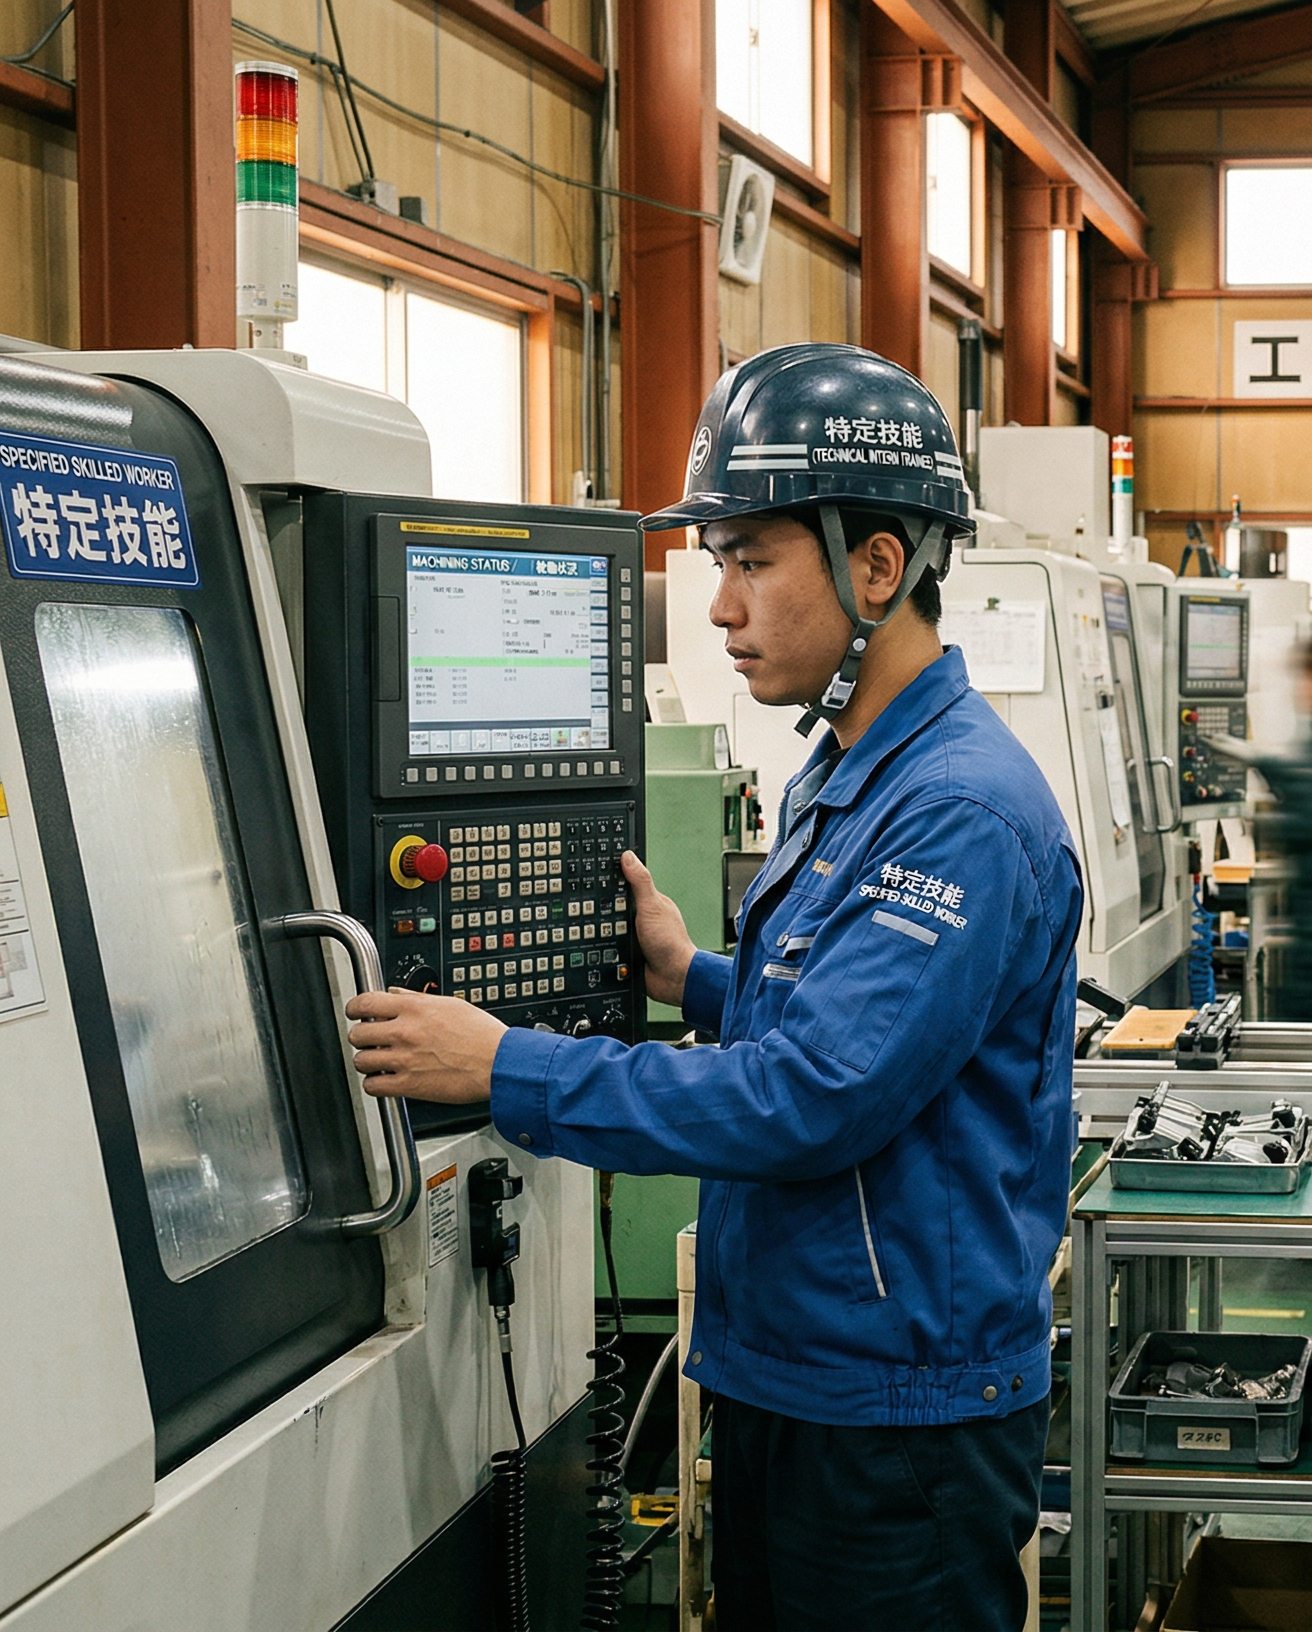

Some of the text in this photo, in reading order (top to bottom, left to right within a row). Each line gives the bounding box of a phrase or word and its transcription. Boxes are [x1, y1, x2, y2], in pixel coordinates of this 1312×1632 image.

[824, 416, 924, 449] 特定技能
[0, 443, 175, 490] SPECIFIED SKILLED WORKER
[11, 482, 187, 569] 特定技能
[471, 557, 511, 572] STATUS
[880, 862, 965, 909] 特定技能
